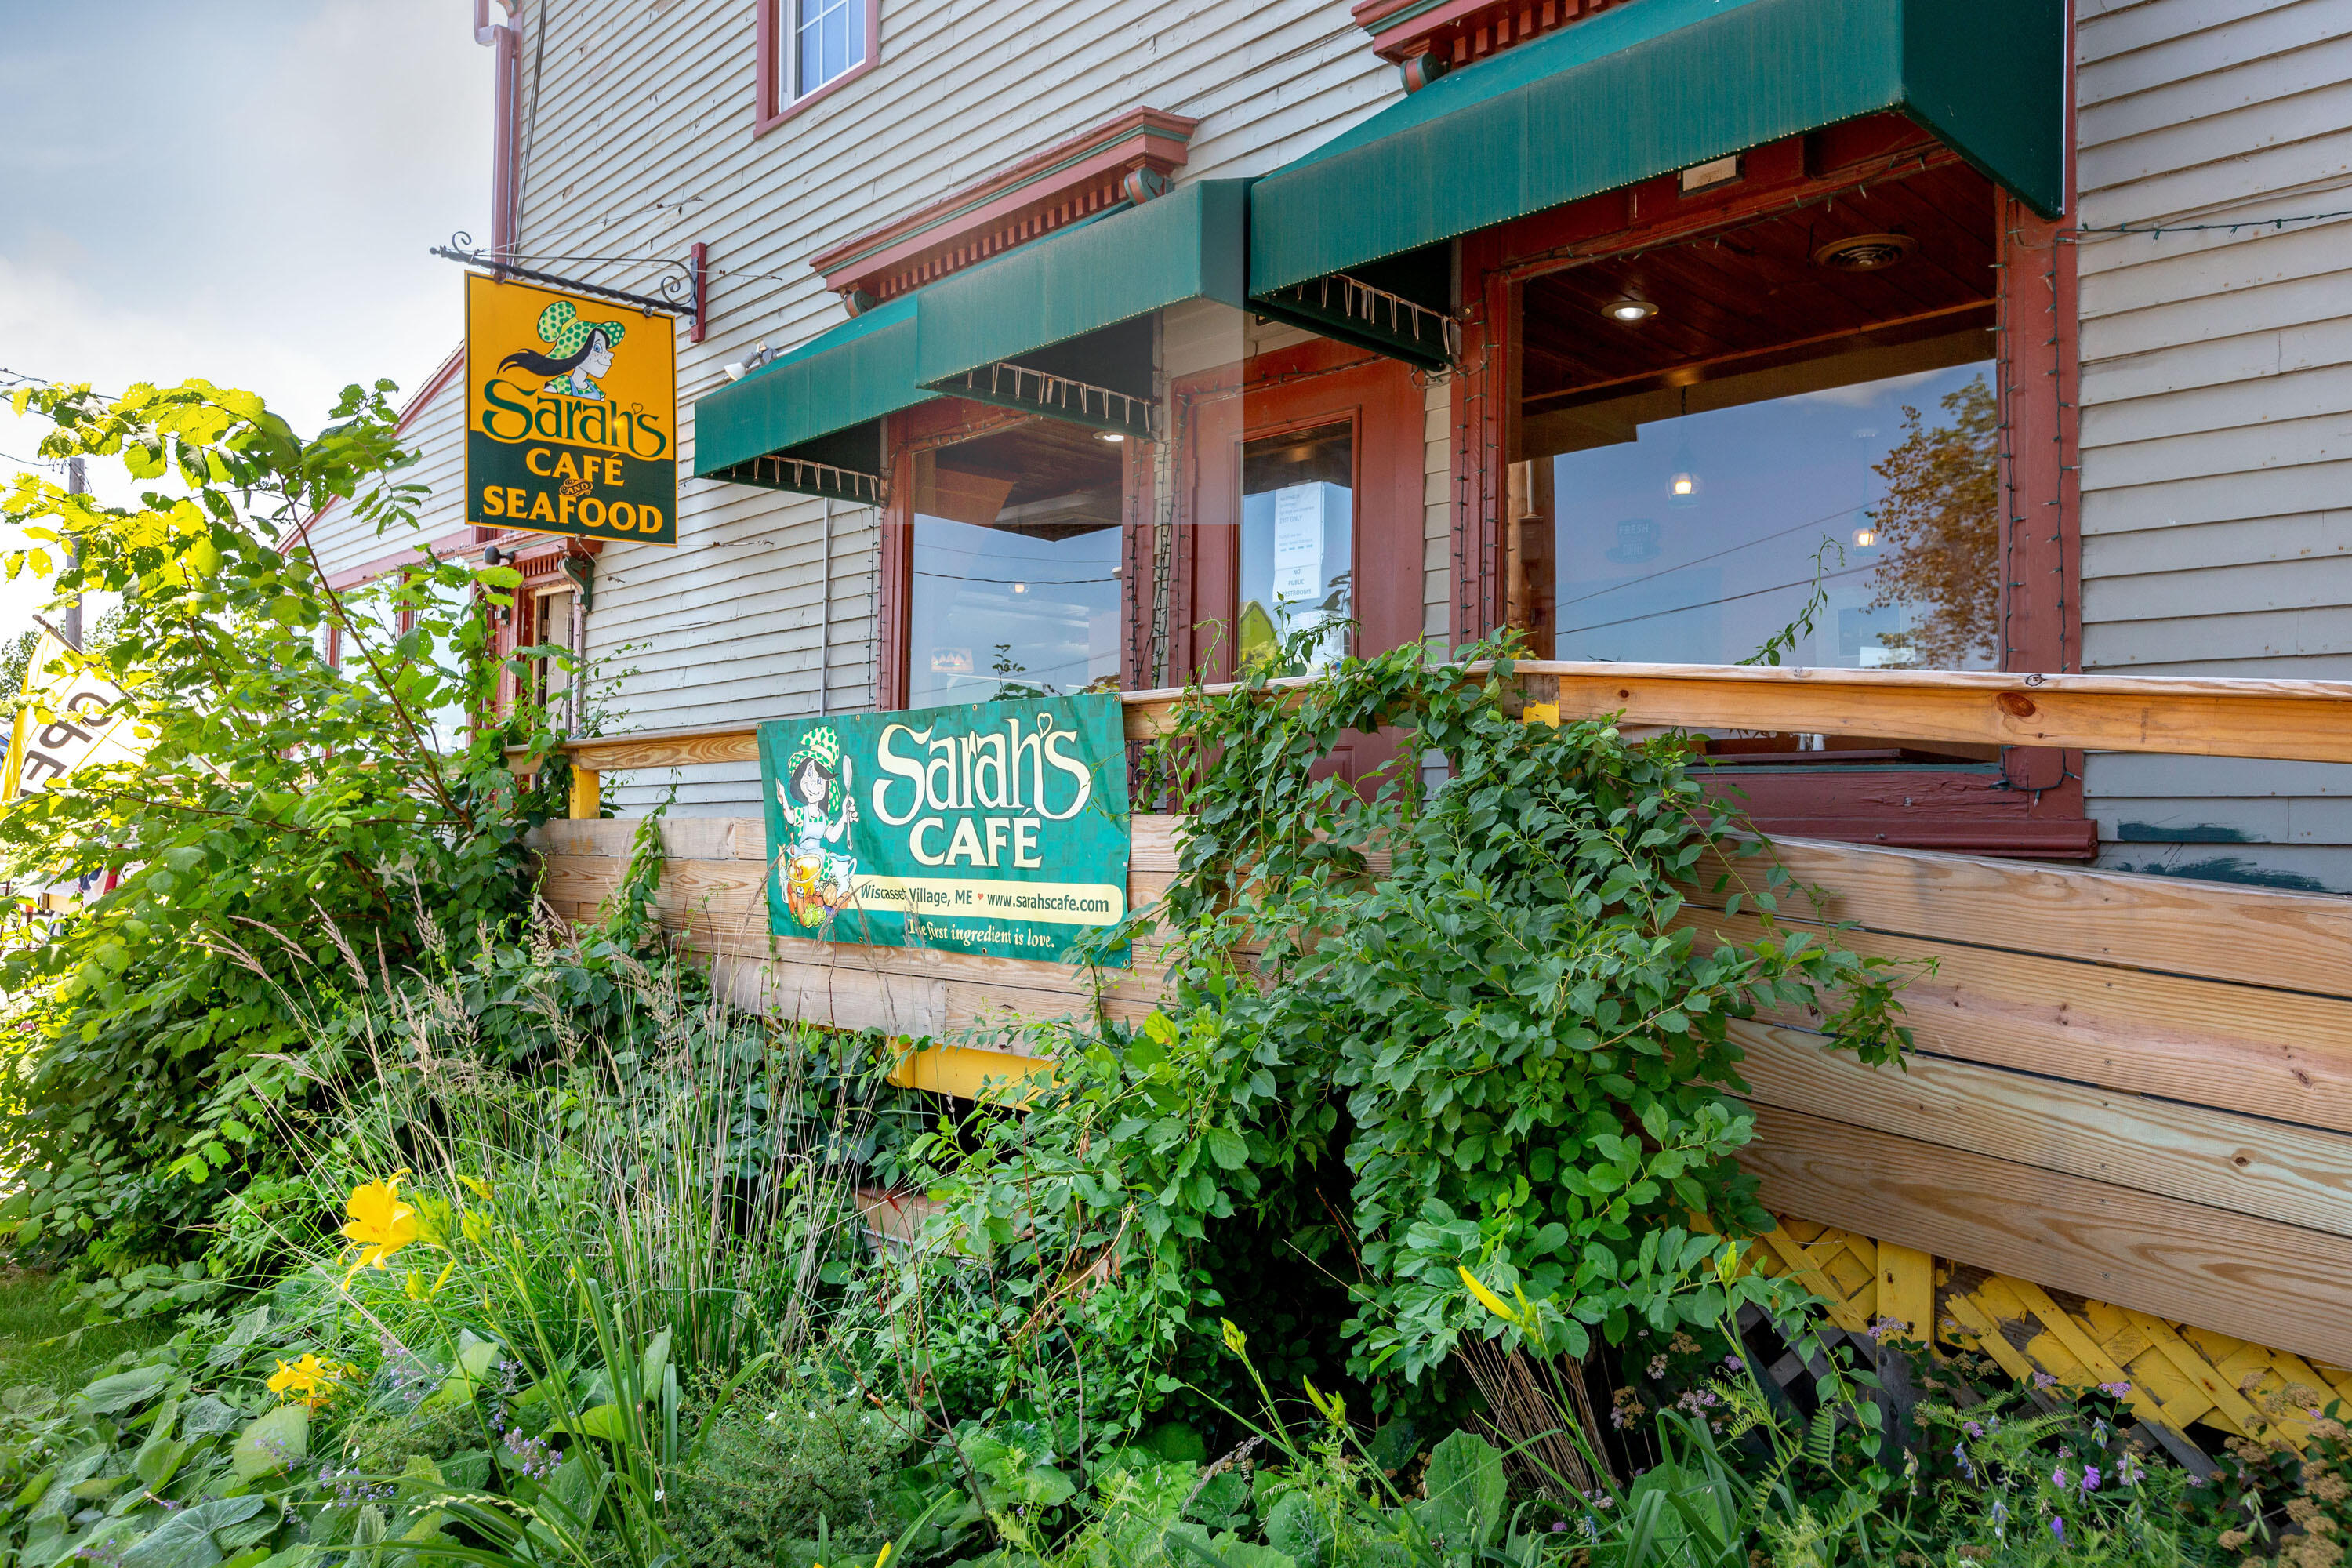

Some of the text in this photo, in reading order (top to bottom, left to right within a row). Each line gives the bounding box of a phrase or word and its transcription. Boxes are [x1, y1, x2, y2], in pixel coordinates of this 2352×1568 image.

[482, 379, 667, 457] Sarah's
[526, 448, 625, 486] CAFÉ
[565, 482, 589, 494] AND
[483, 485, 663, 533] SEAFOOD
[20, 692, 114, 797] OPE
[873, 713, 1091, 826] Sarah's
[909, 808, 1043, 868] CAFÉ
[861, 884, 1109, 912] Wiscasset Village, ME www.sarahscafe.com
[927, 921, 948, 941] first
[951, 924, 1011, 946] ingredient
[1014, 927, 1024, 946] is
[1027, 928, 1054, 948] love.
